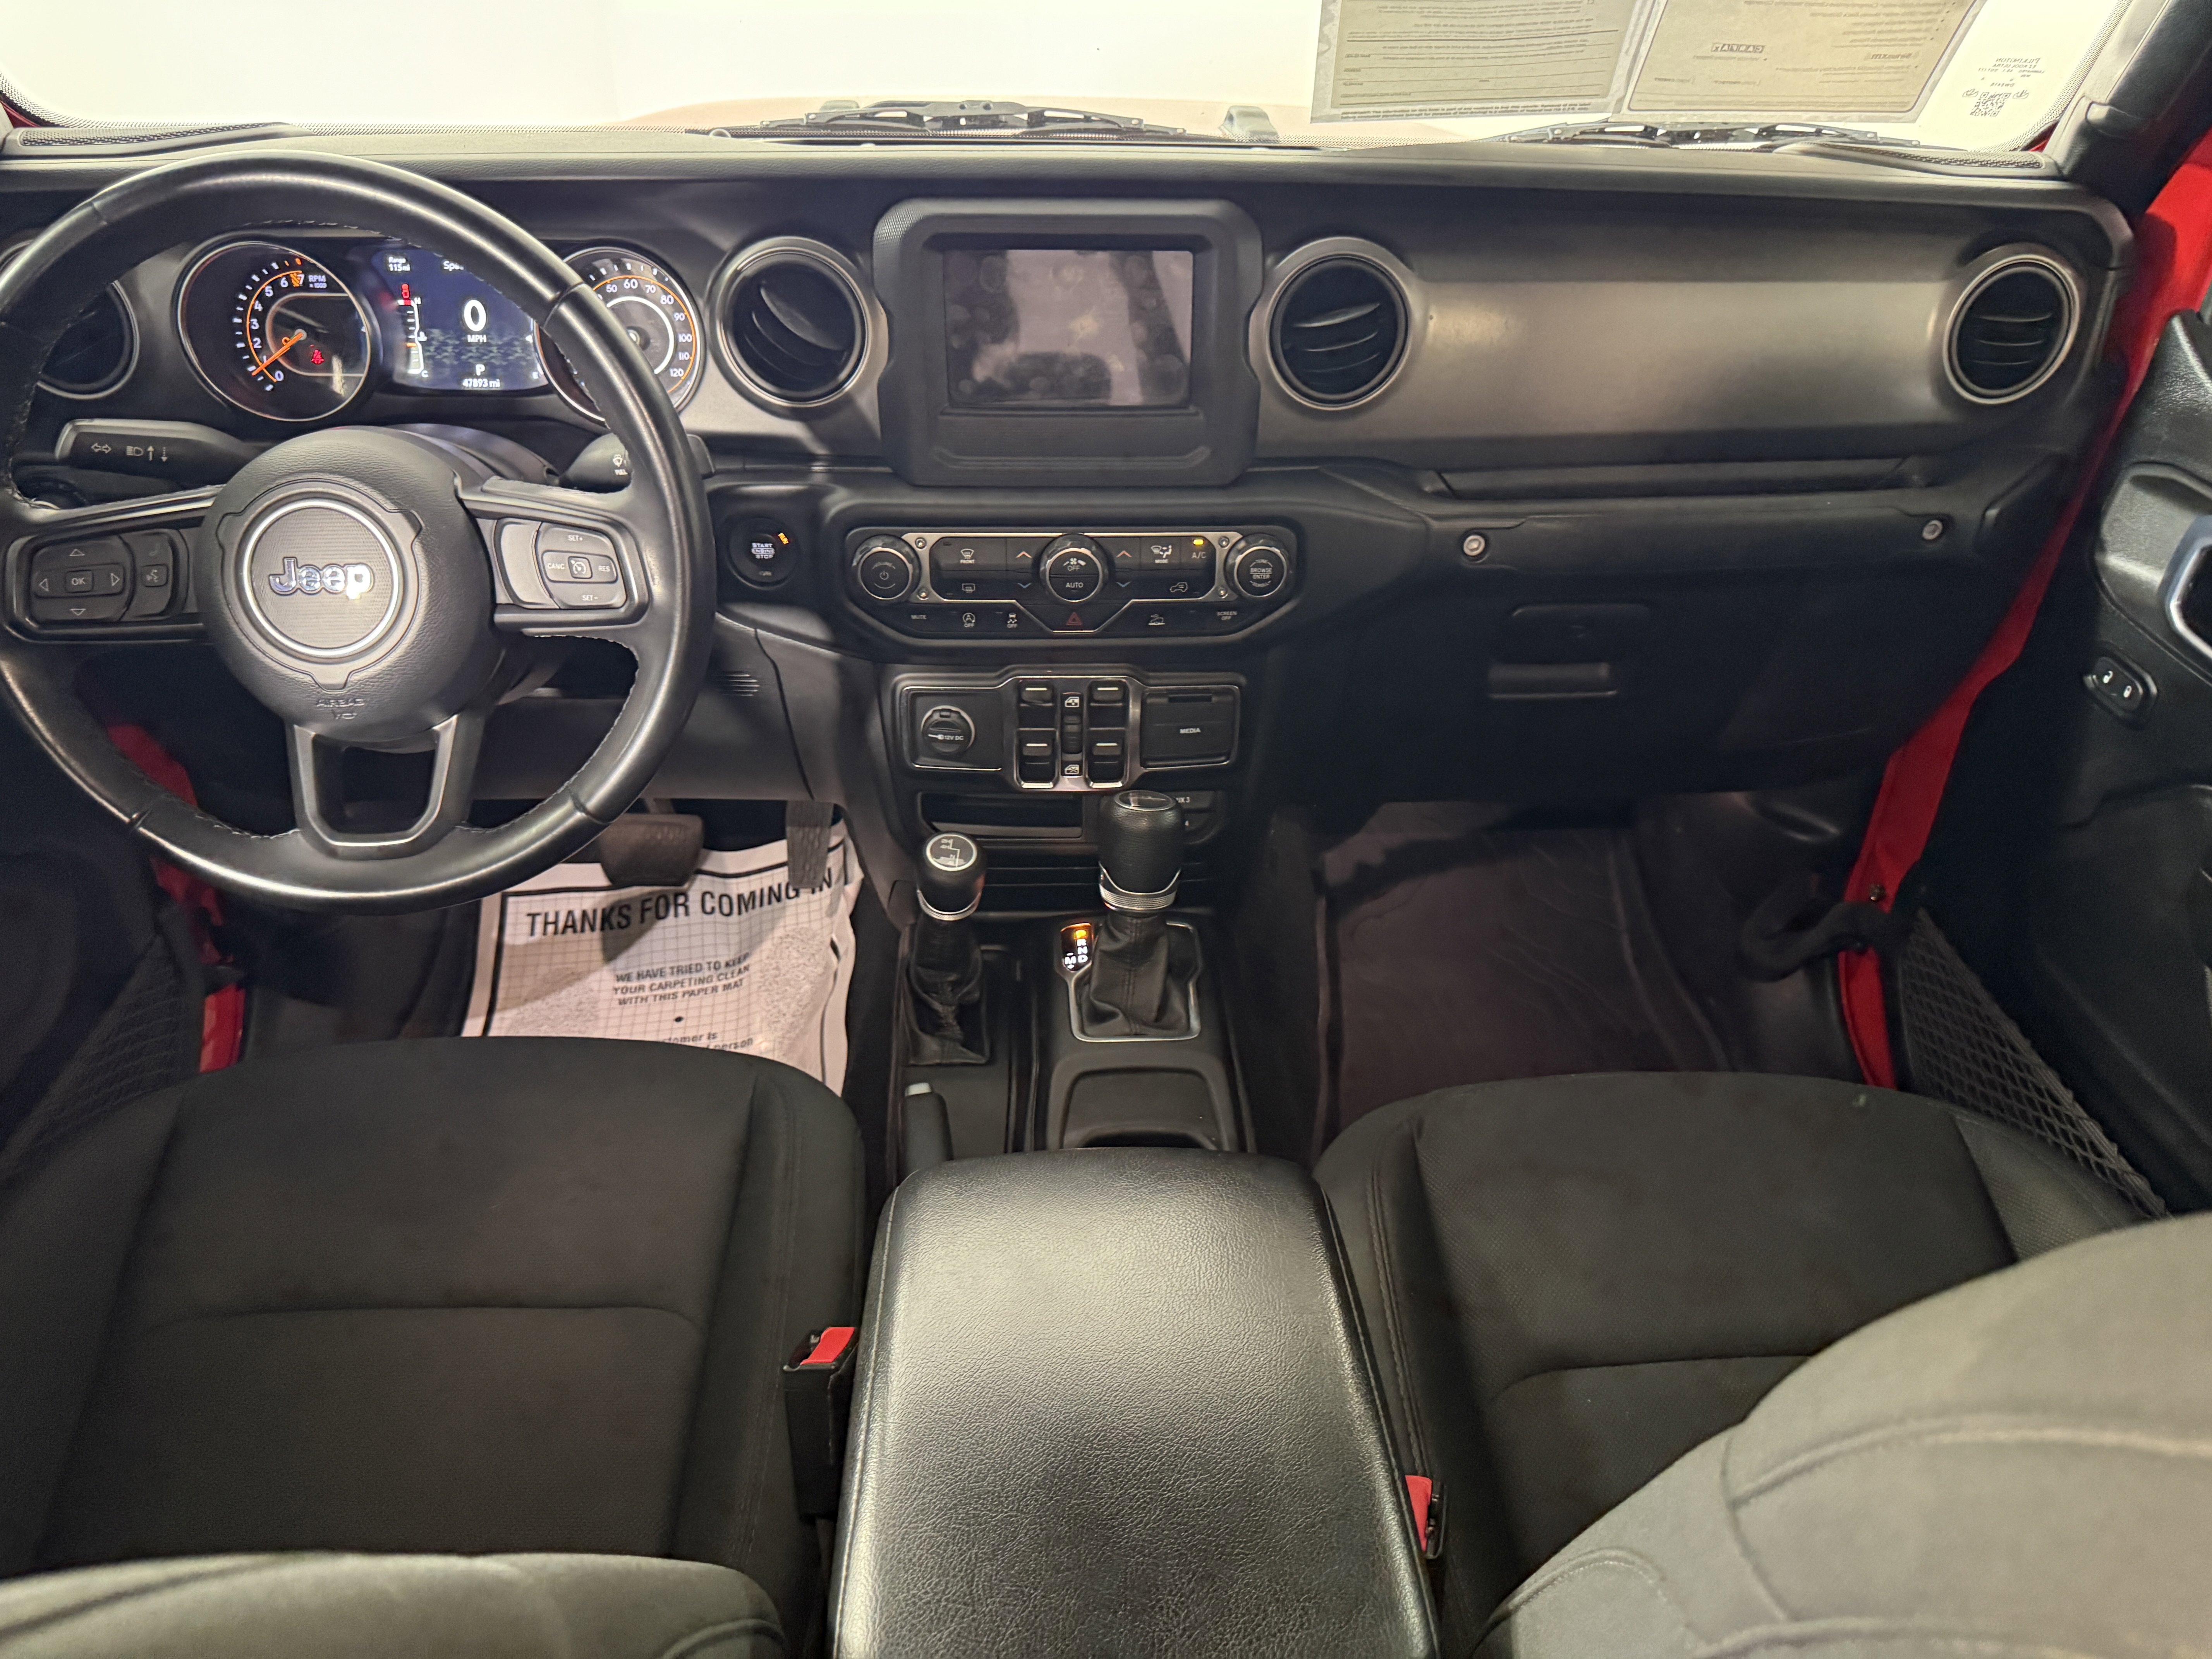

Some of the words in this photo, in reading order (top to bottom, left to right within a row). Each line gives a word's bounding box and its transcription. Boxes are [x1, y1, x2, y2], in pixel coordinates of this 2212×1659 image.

[280, 278, 288, 288] 6
[297, 274, 304, 285] 7
[623, 278, 638, 289] 60
[265, 286, 273, 297] 5
[606, 284, 618, 293] 50
[645, 285, 656, 293] 70
[660, 295, 674, 305] 80
[254, 301, 263, 311] 4
[464, 299, 486, 331] 0
[673, 313, 685, 321] 90
[250, 319, 259, 330] 3
[252, 338, 262, 348] 2
[467, 335, 487, 343] MPH
[678, 334, 692, 342] 100
[678, 352, 690, 361] 110
[476, 364, 485, 376] P
[670, 368, 684, 377] 120
[275, 370, 284, 381] 0
[462, 378, 488, 387] 47893
[489, 379, 501, 387] mi
[71, 577, 85, 586] OK
[268, 556, 375, 599] Jeep
[527, 903, 632, 937] THANKS
[640, 892, 690, 924] FOR
[701, 882, 800, 917] COMING
[1077, 938, 1086, 946] R
[1077, 946, 1088, 955] N
[1065, 956, 1076, 965] M
[1078, 955, 1088, 963] D
[615, 972, 632, 982] WE
[637, 967, 667, 979] HAVE
[668, 962, 702, 975] TRIED
[706, 961, 721, 971] TO
[613, 985, 646, 994] YOUR
[650, 975, 714, 992] CARPETING
[717, 964, 750, 982] CLEAN
[618, 994, 648, 1005] WITH
[653, 991, 678, 1002] THIS
[682, 985, 719, 998] PAPER
[722, 978, 745, 991] MAT
